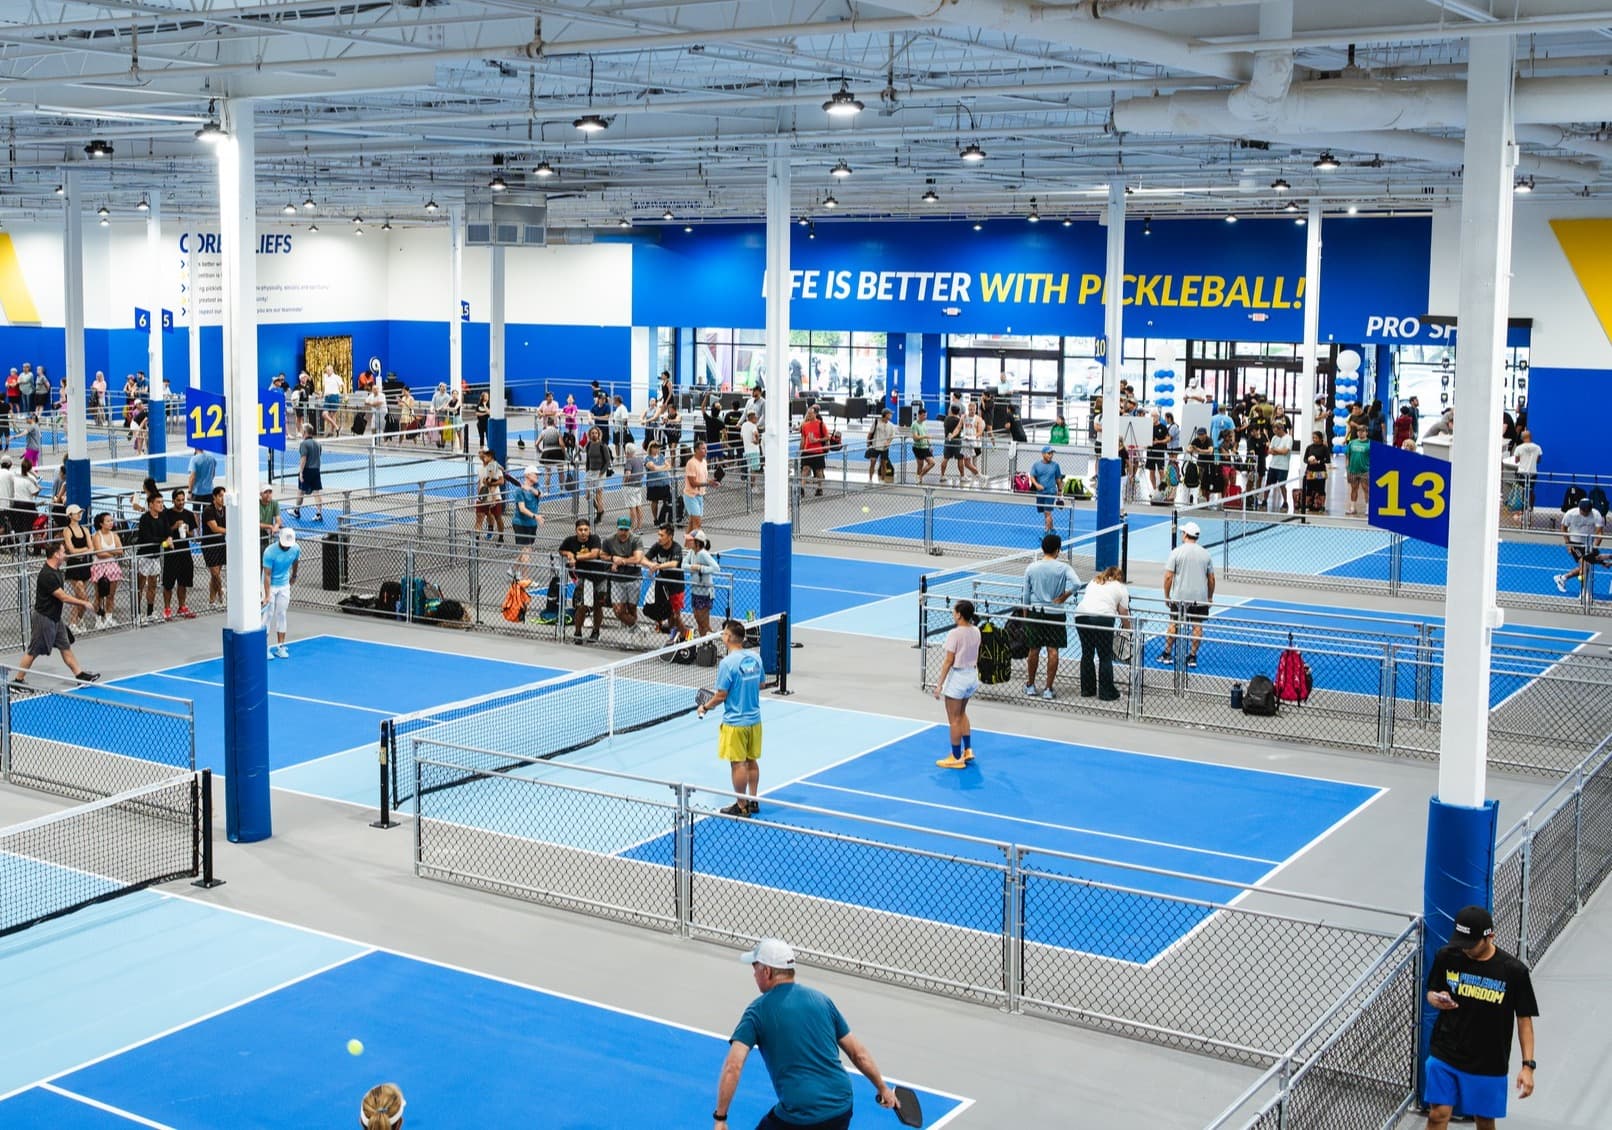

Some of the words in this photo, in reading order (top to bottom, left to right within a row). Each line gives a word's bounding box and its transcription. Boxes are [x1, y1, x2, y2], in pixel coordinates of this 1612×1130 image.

[761, 270, 820, 299] FE
[825, 270, 852, 299] IS
[856, 271, 971, 302] BETTER
[980, 272, 1069, 304] WITH
[139, 313, 147, 328] 6
[163, 314, 170, 328] 5
[1366, 316, 1420, 338] PRO
[1095, 339, 1106, 358] 10
[189, 404, 223, 440] 12
[1375, 470, 1446, 519] 13
[1457, 983, 1505, 1004] KINGDOM
